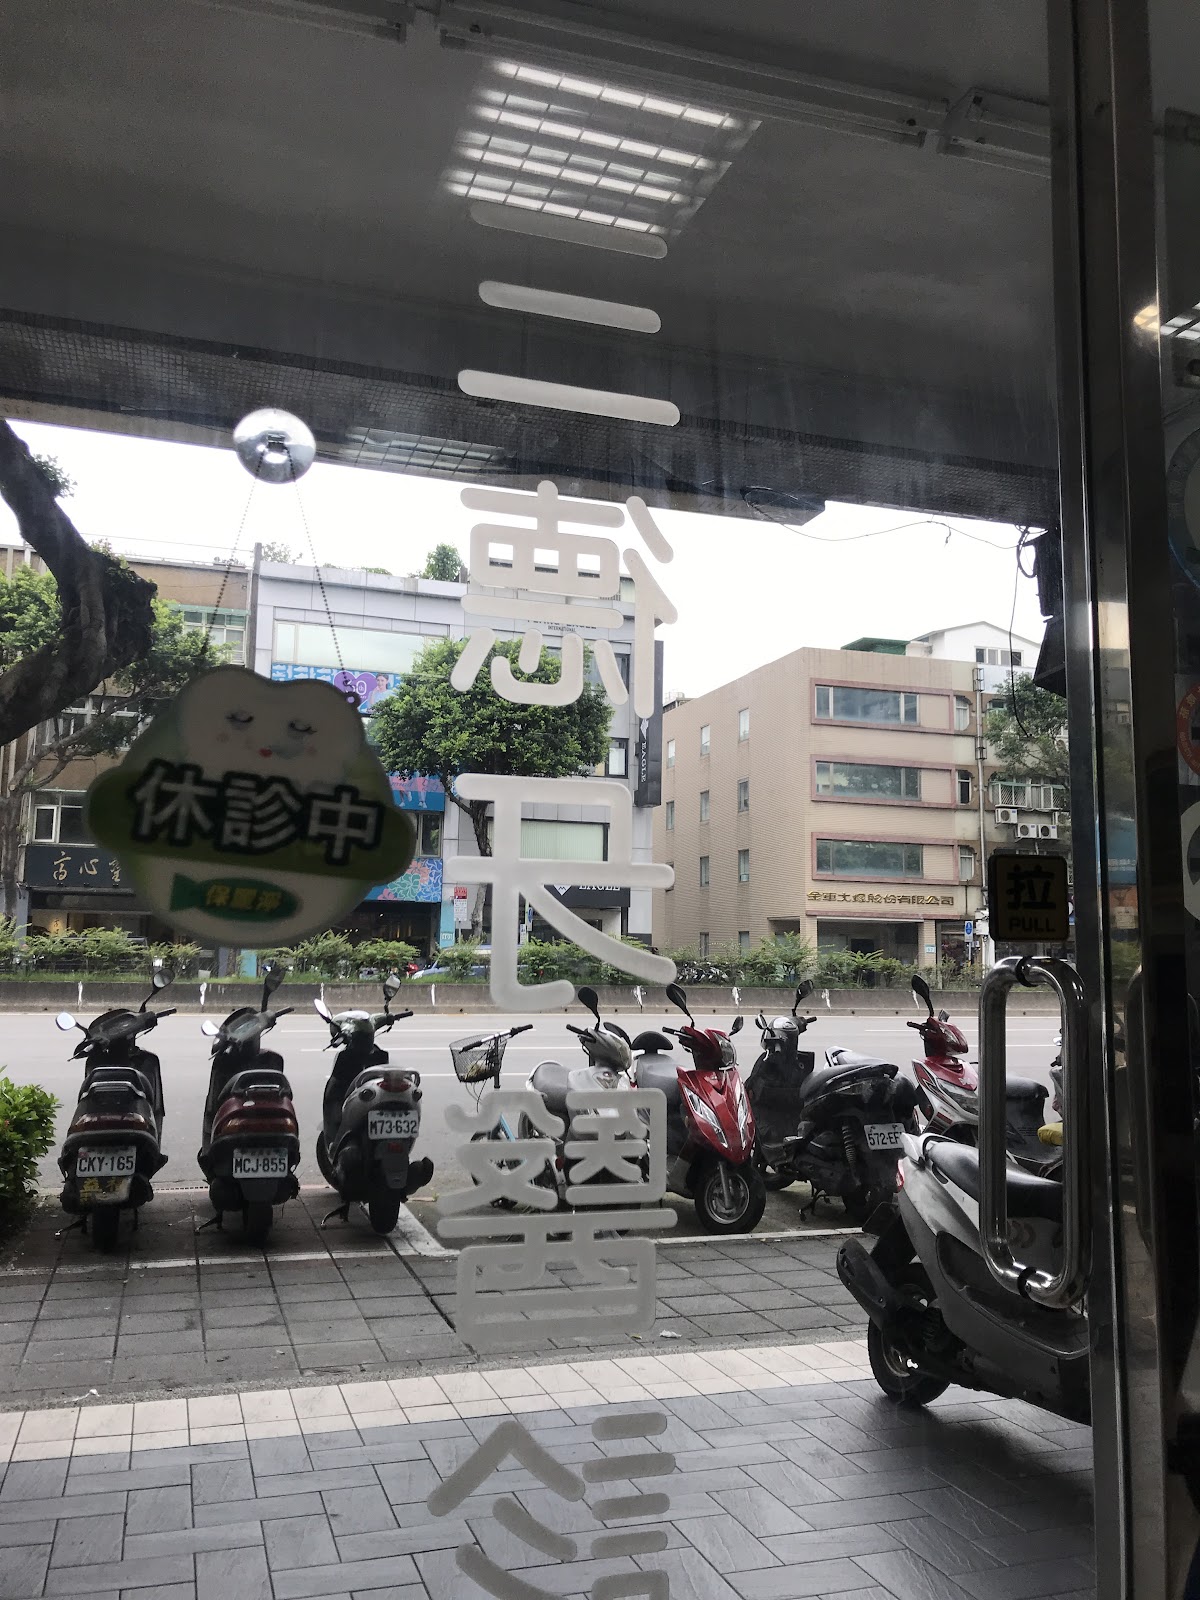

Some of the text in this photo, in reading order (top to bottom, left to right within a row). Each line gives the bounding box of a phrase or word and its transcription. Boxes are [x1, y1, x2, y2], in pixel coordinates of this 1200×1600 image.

[132, 762, 382, 863] 休診中
[1006, 863, 1057, 910] 拉
[1009, 916, 1056, 932] PULL
